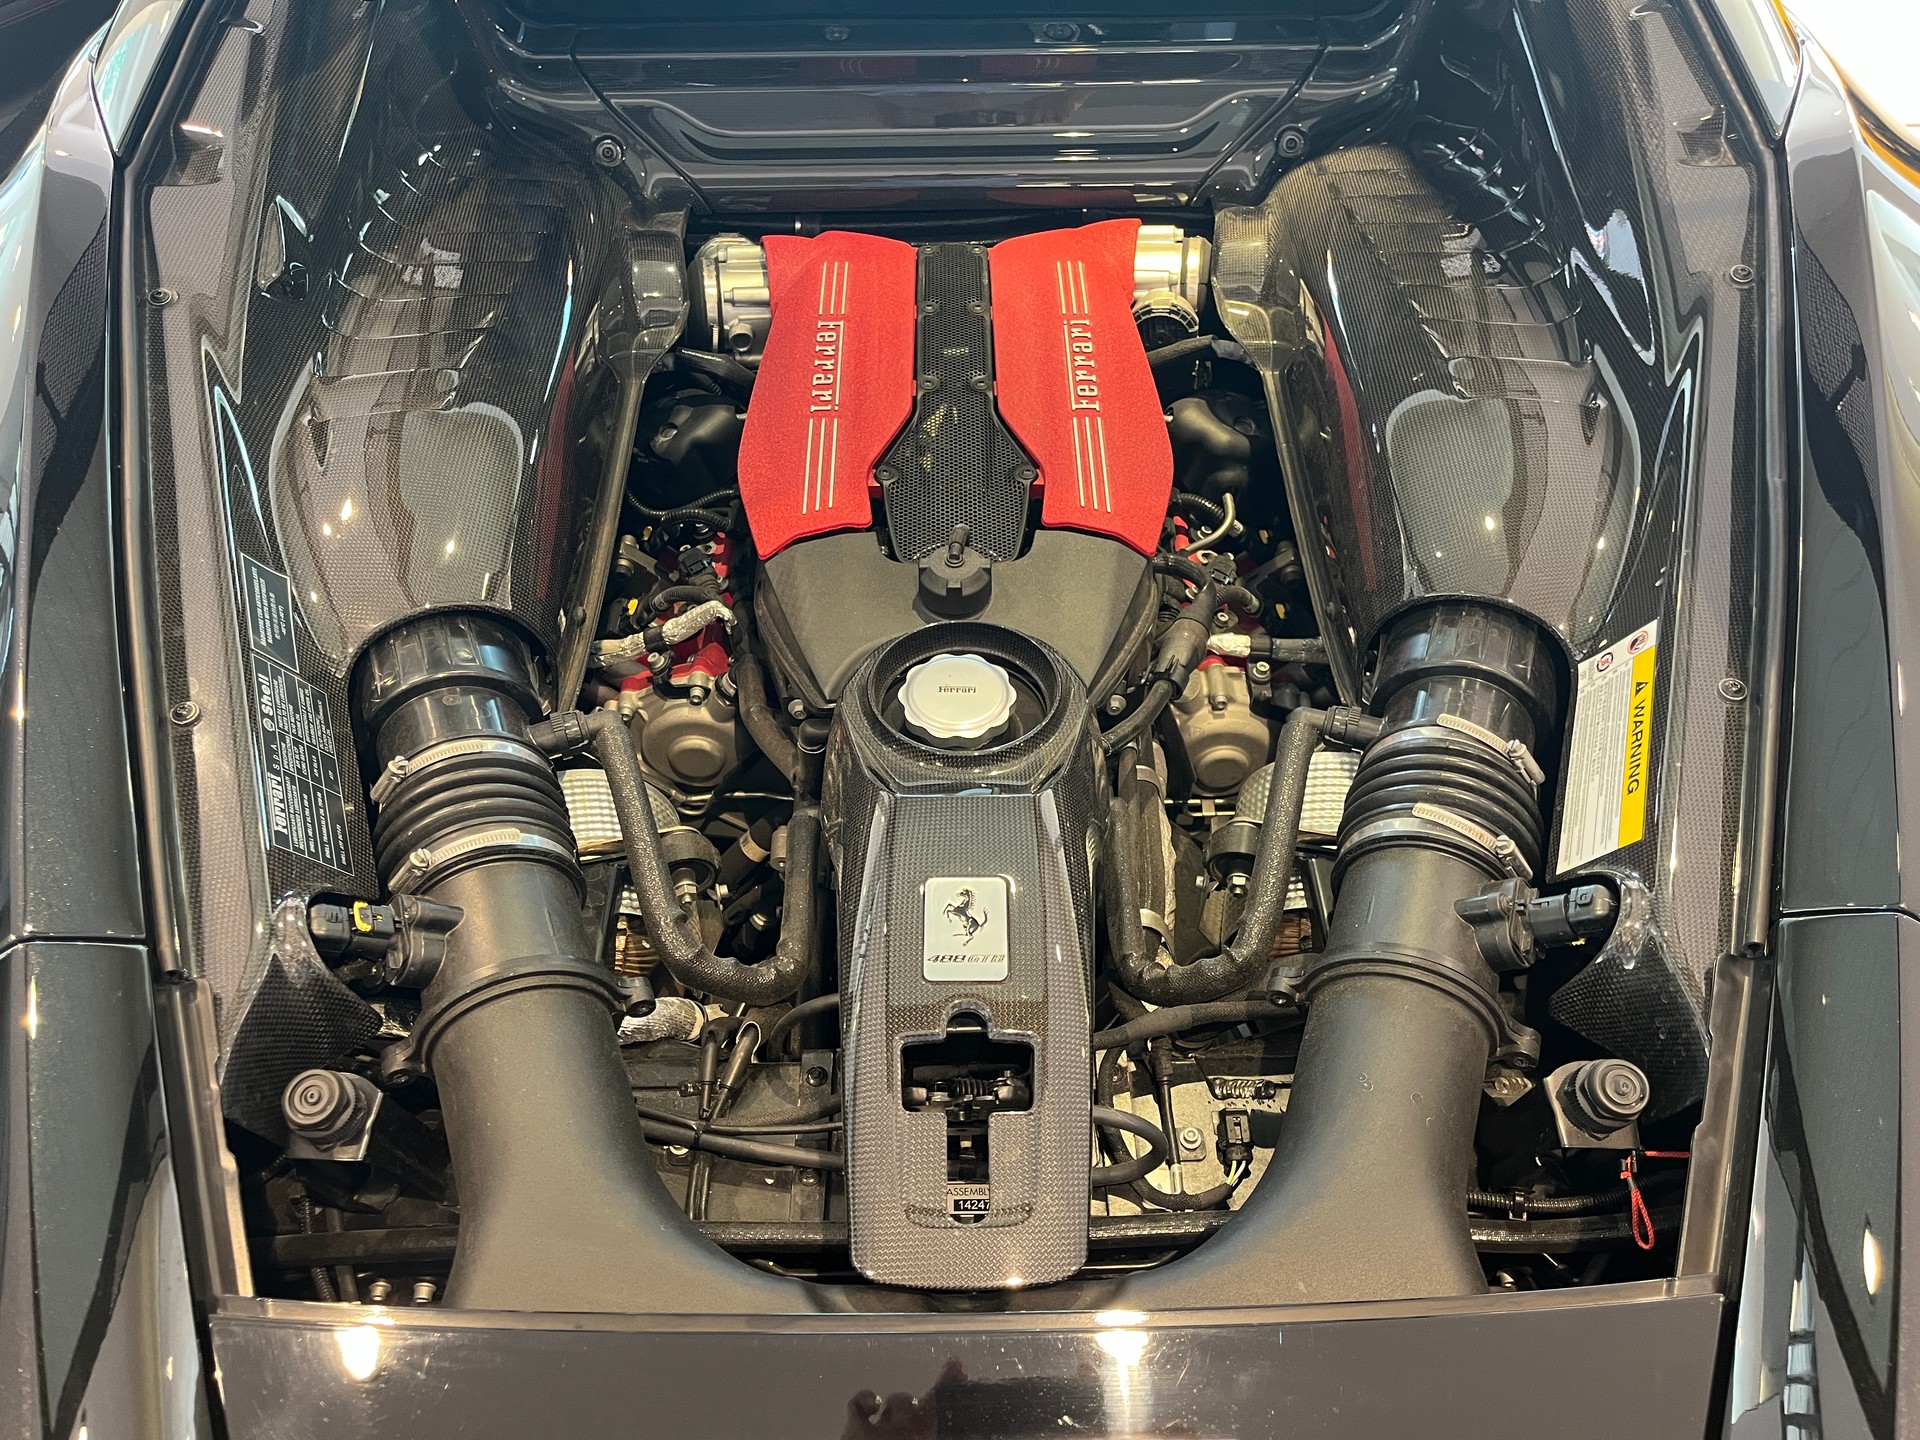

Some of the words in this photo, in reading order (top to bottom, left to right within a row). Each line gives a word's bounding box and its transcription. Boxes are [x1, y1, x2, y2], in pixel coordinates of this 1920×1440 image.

[810, 320, 844, 412] Ferrari
[1063, 319, 1100, 411] Ferrari
[258, 672, 272, 716] Shell
[938, 684, 977, 694] Ferrari
[1626, 698, 1645, 796] WARNING
[268, 772, 286, 834] Ferrari
